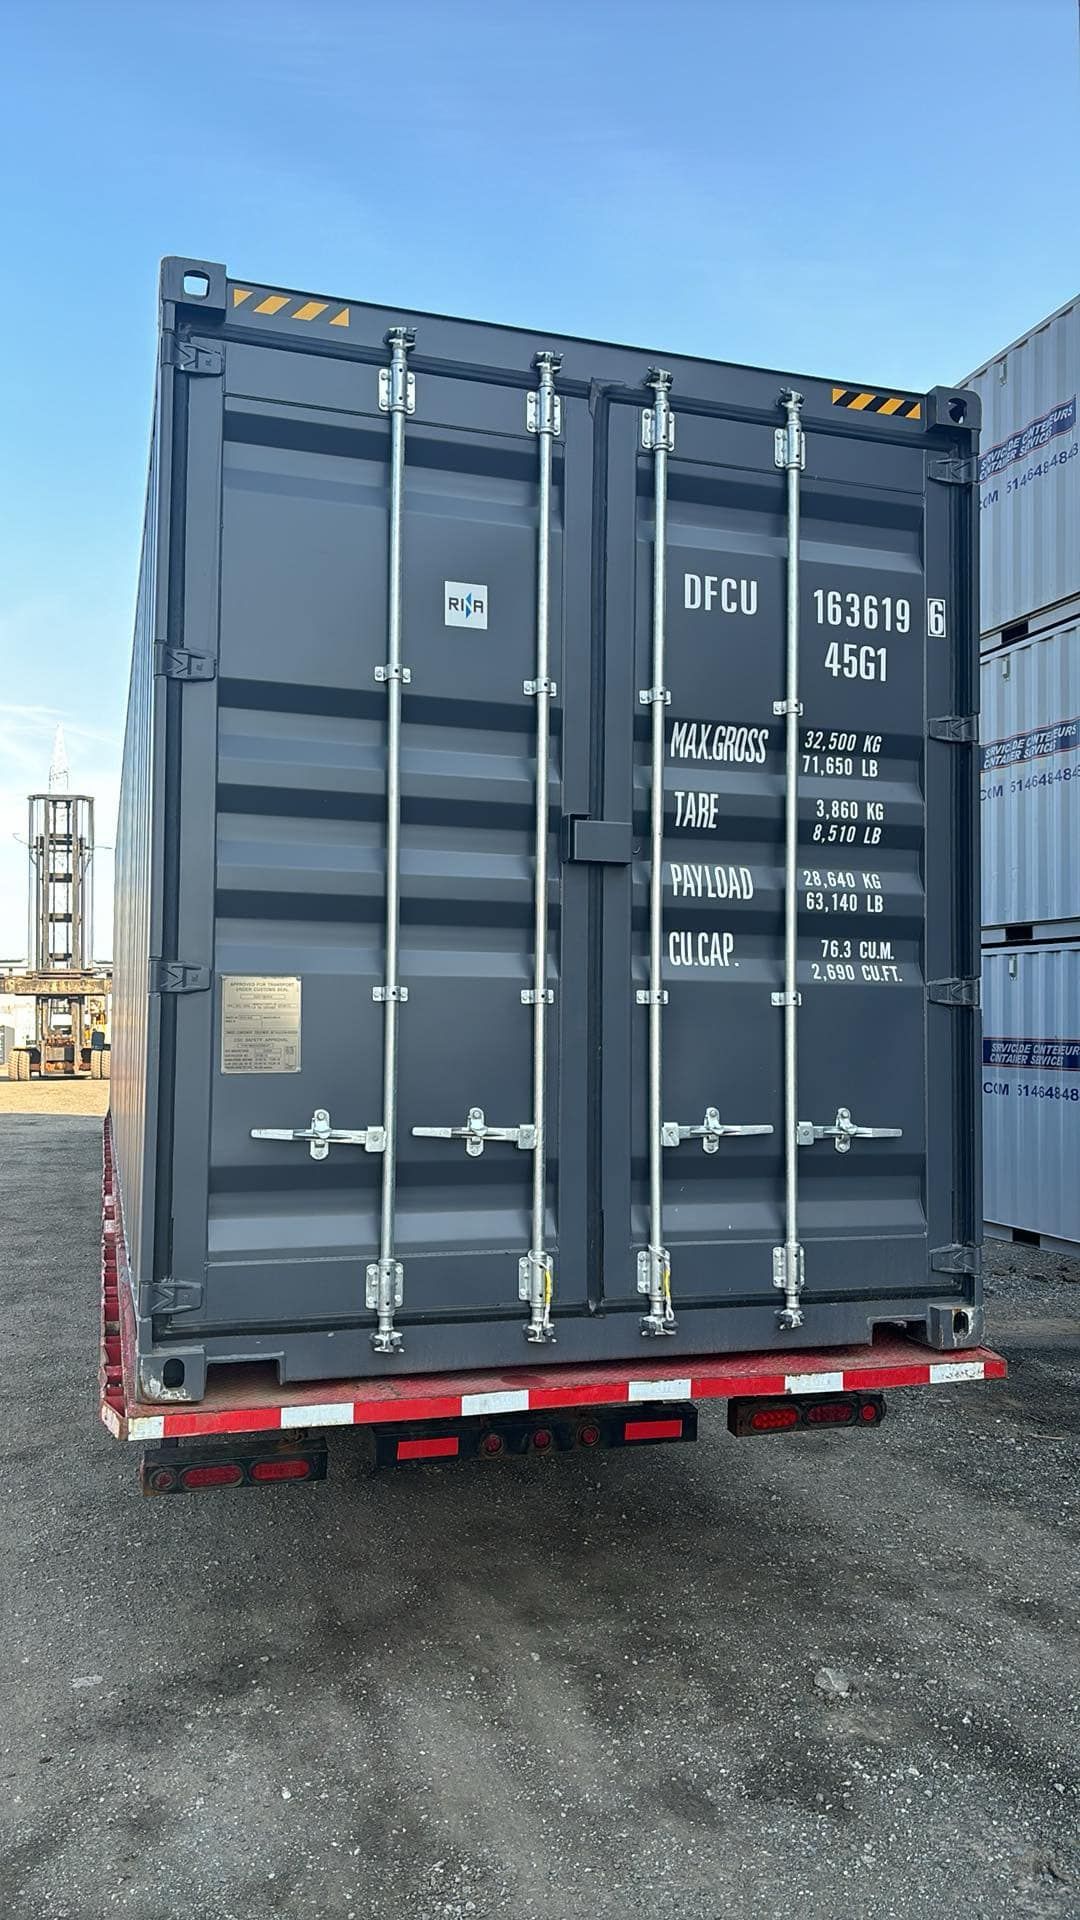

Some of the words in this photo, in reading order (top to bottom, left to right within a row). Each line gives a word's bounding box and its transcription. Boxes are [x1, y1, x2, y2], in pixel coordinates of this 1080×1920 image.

[1008, 437, 1021, 451] DE
[684, 573, 758, 616] DFCU
[814, 588, 911, 634] 163619
[928, 599, 947, 637] 6
[824, 641, 888, 682] 45G1
[670, 721, 769, 764] MAX.GROSS
[804, 730, 857, 753] 32,500
[862, 734, 883, 754] KG
[1012, 739, 1025, 751] DE
[802, 755, 853, 778] 71,650
[861, 757, 879, 778] LB
[674, 790, 719, 829] TARE
[815, 799, 859, 821] 3,860
[866, 802, 884, 821] KG
[812, 824, 856, 844] 8,510
[863, 827, 882, 845] LB
[669, 863, 755, 901] PAYLOAD
[802, 869, 856, 889] 28,640
[861, 872, 882, 890] KG
[805, 891, 858, 914] 63,140
[866, 894, 884, 913] LB
[668, 931, 740, 968] CU.CAP.
[820, 939, 852, 959] 76.3
[859, 941, 895, 961] CU.M.
[810, 963, 857, 983] 2,690
[861, 965, 904, 984] CU.FT.
[1019, 1044, 1032, 1054] DE
